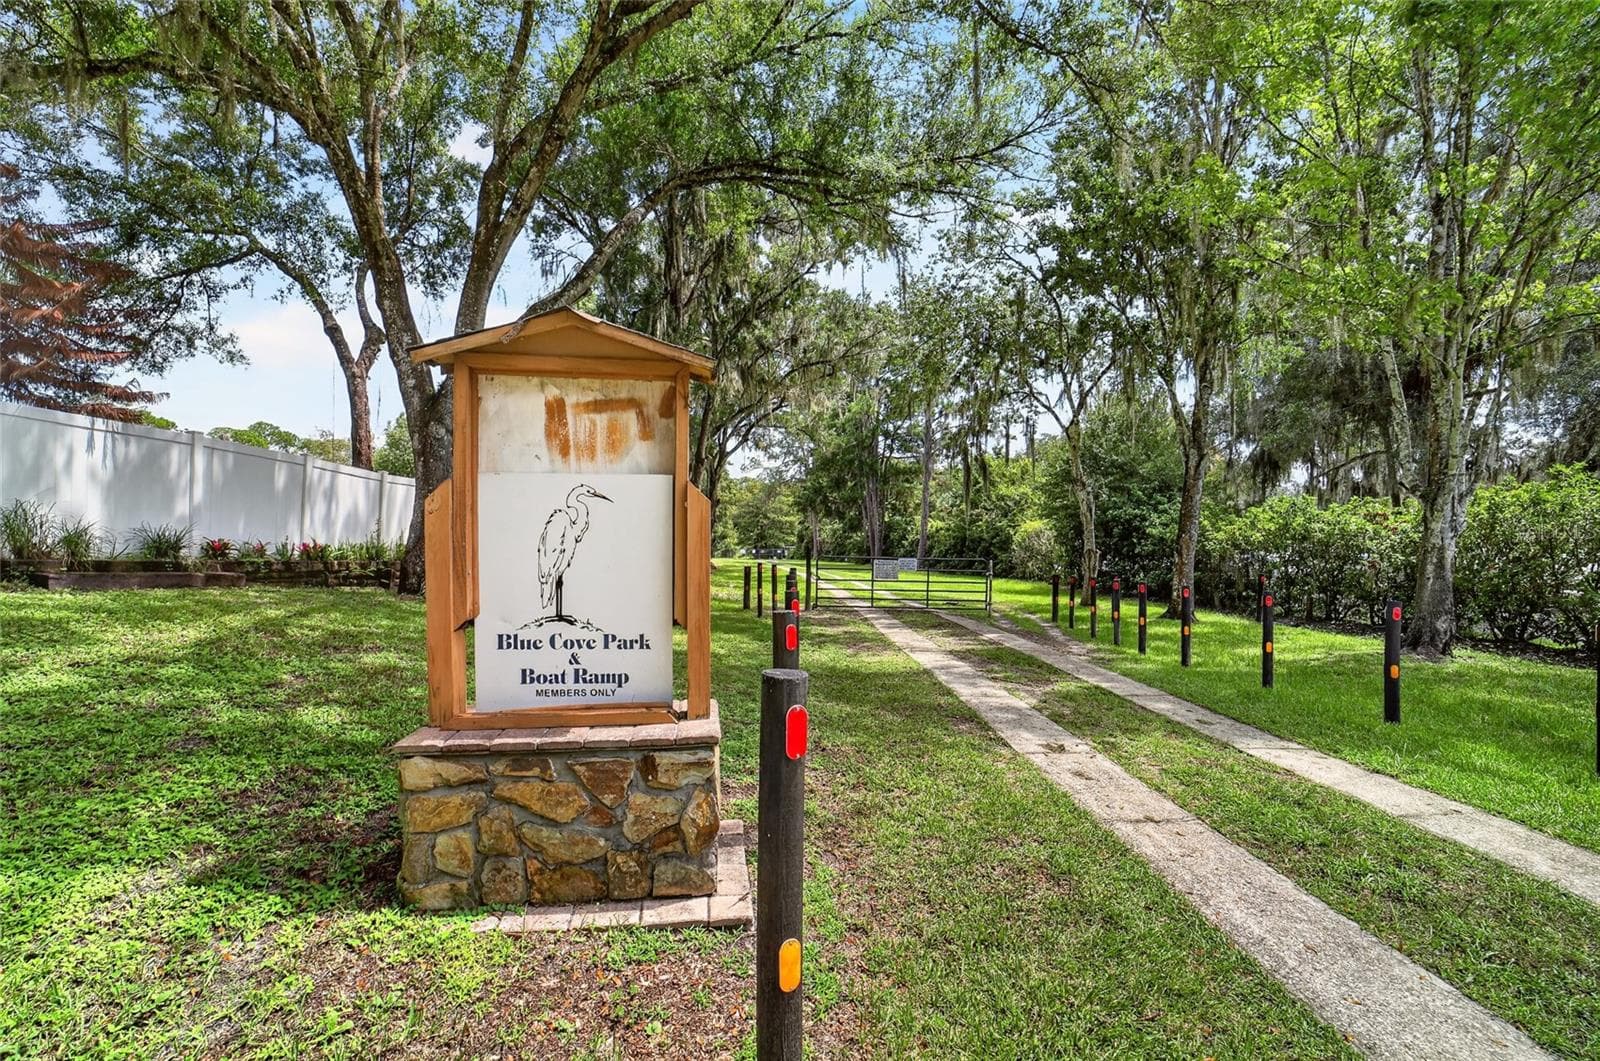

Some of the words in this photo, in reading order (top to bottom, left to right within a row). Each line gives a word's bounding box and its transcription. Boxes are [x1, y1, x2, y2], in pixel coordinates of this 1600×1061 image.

[497, 633, 543, 650] Blue
[549, 633, 596, 650] Cove
[603, 633, 651, 650] Park
[568, 652, 581, 665] &
[520, 668, 567, 685] Boat
[573, 668, 629, 688] Ramp
[535, 688, 587, 697] MEMBERS
[590, 688, 617, 697] ONLY
